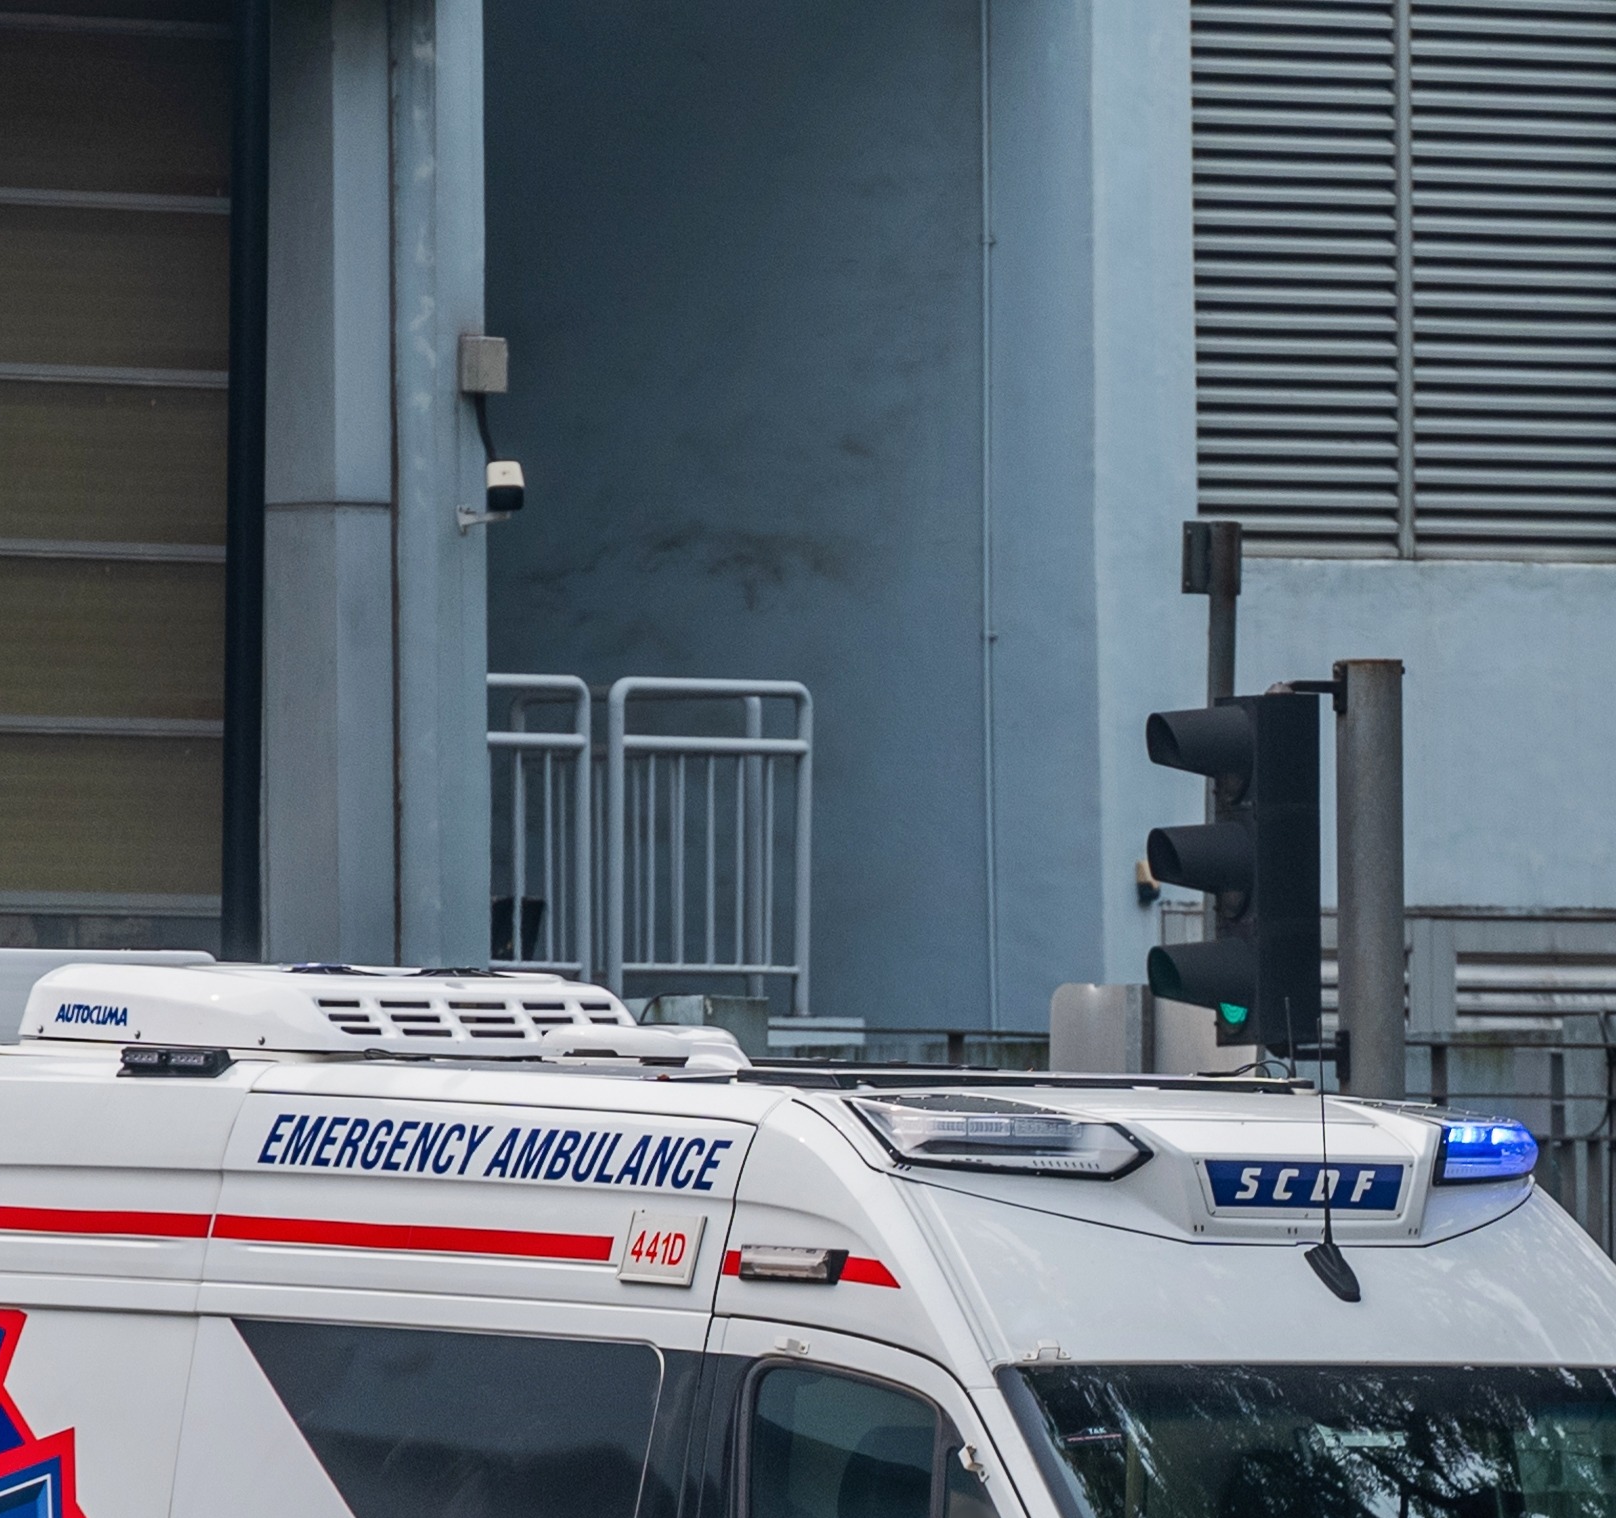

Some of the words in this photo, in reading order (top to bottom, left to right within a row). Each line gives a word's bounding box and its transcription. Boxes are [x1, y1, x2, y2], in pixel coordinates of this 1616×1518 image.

[257, 1114, 493, 1176] EMERGENCY
[483, 1127, 733, 1190] AMBULANCE
[1234, 1167, 1376, 1203] SCDF
[630, 1230, 686, 1266] 441D
